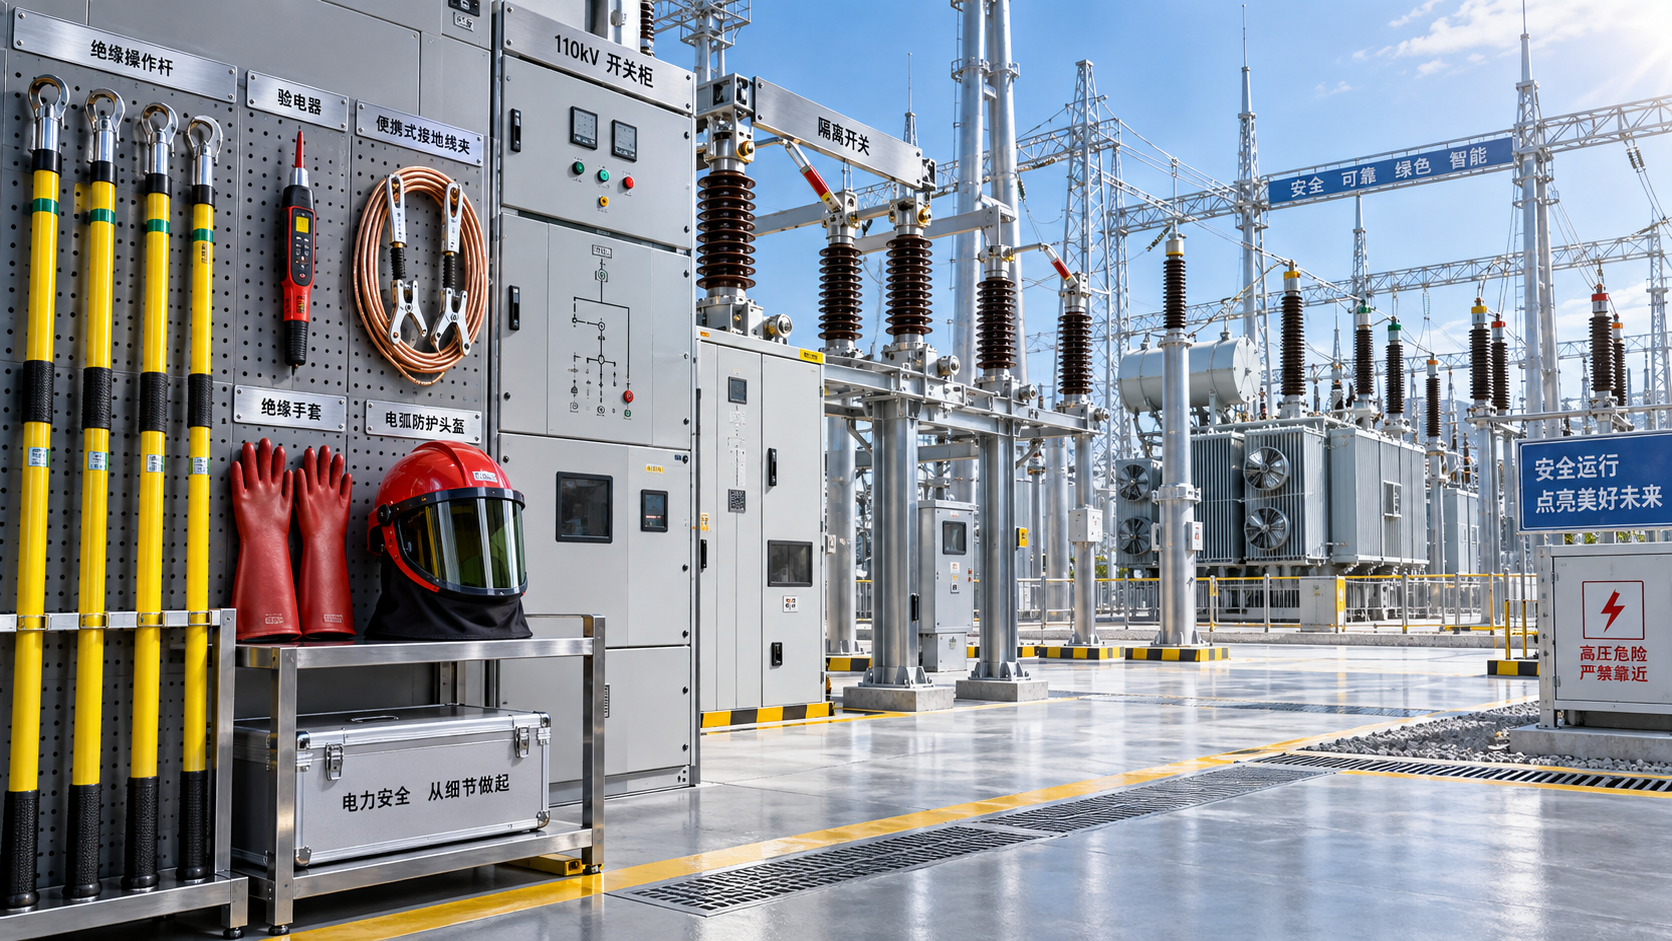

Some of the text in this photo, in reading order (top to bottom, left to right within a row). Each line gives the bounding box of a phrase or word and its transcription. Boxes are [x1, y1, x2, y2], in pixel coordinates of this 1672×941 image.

[90, 40, 173, 76] 绝缘操作杆
[555, 35, 653, 87] 110kV 开关柜
[278, 89, 321, 115] 验电器
[376, 115, 470, 154] 便携式接地线夹
[818, 117, 869, 156] 隔离开关
[1291, 147, 1487, 197] 安全 可靠 绿色 智能
[261, 398, 321, 421] 绝缘手套
[386, 411, 464, 434] 电弧防护头盔
[1535, 454, 1618, 481] 安全运行
[1536, 484, 1663, 513] 点亮美好未来
[1580, 645, 1647, 662] 高压危险
[1580, 665, 1648, 682] 严禁靠近
[343, 774, 509, 812] 电力安全 从细节做起
